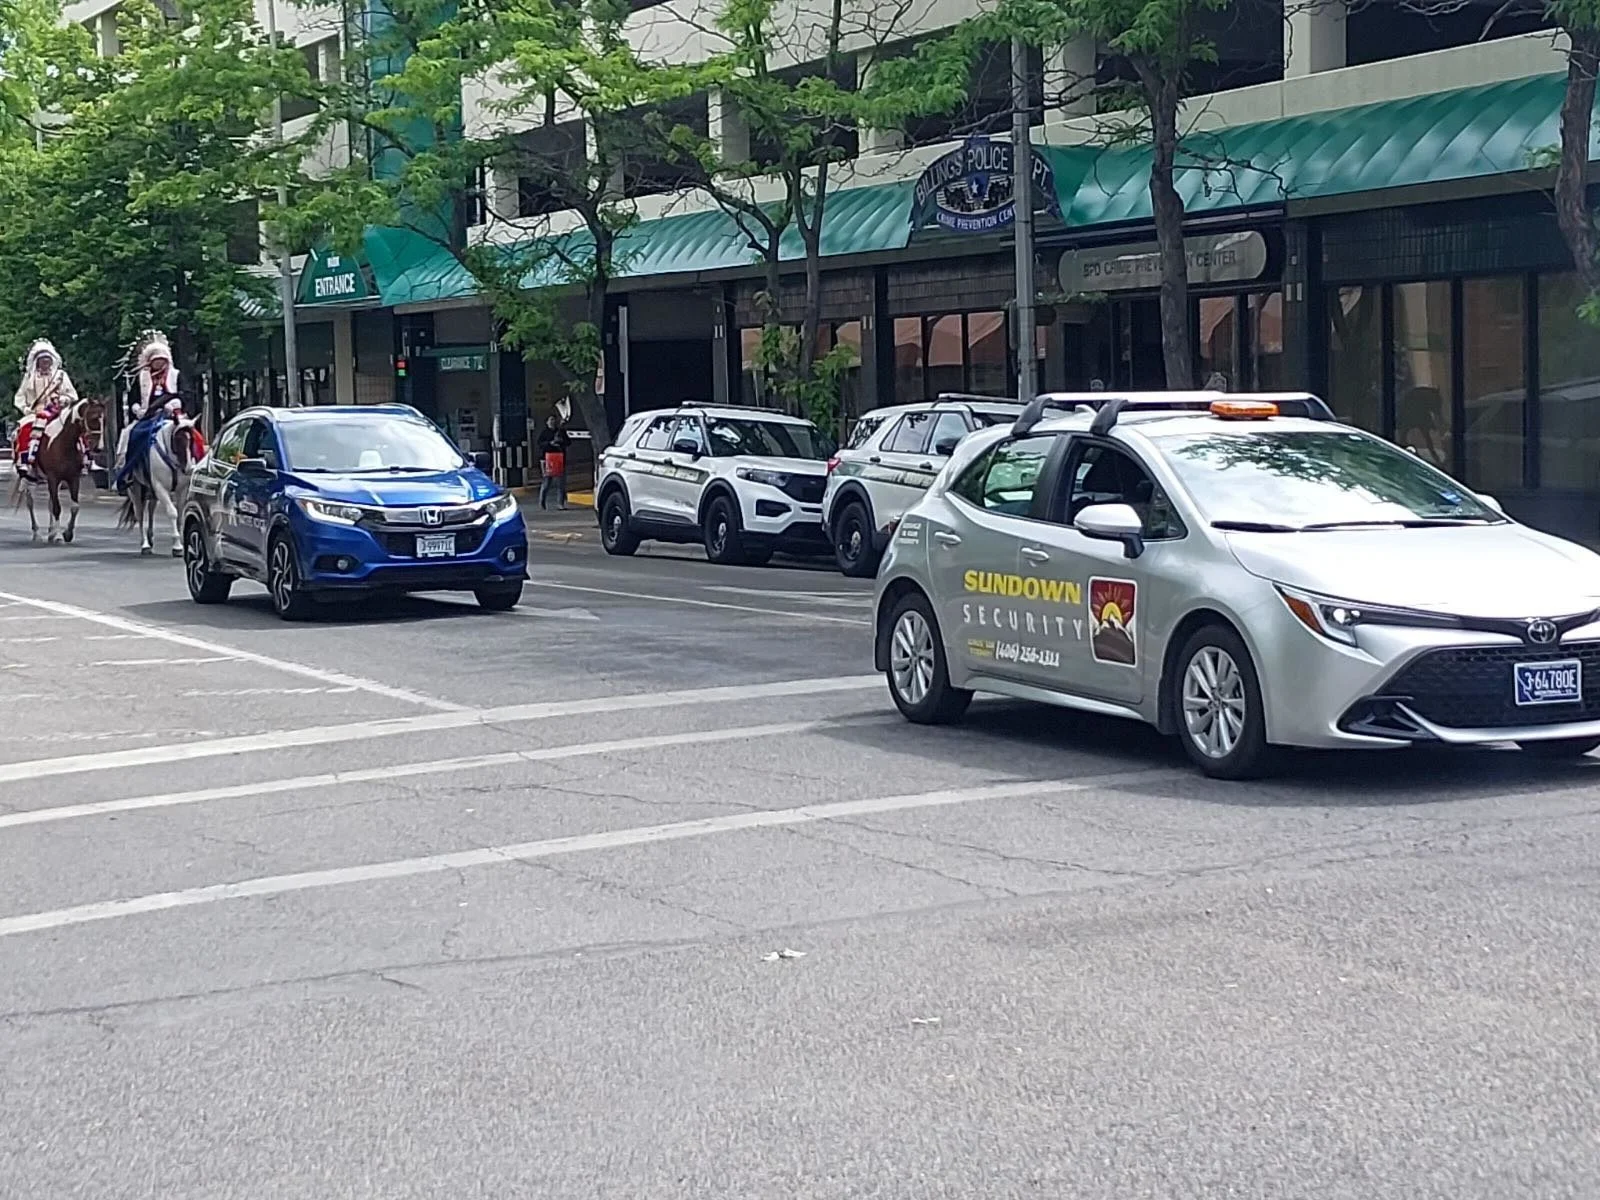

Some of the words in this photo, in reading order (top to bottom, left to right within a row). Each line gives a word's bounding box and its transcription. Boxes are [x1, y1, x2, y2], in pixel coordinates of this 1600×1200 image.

[915, 152, 964, 206] BILLINGS
[967, 146, 1008, 172] POLICE
[957, 215, 998, 230] PREVENTION
[314, 272, 356, 297] ENTRANCE
[963, 569, 1082, 605] SUNDOWN
[963, 603, 1083, 640] SECURITY
